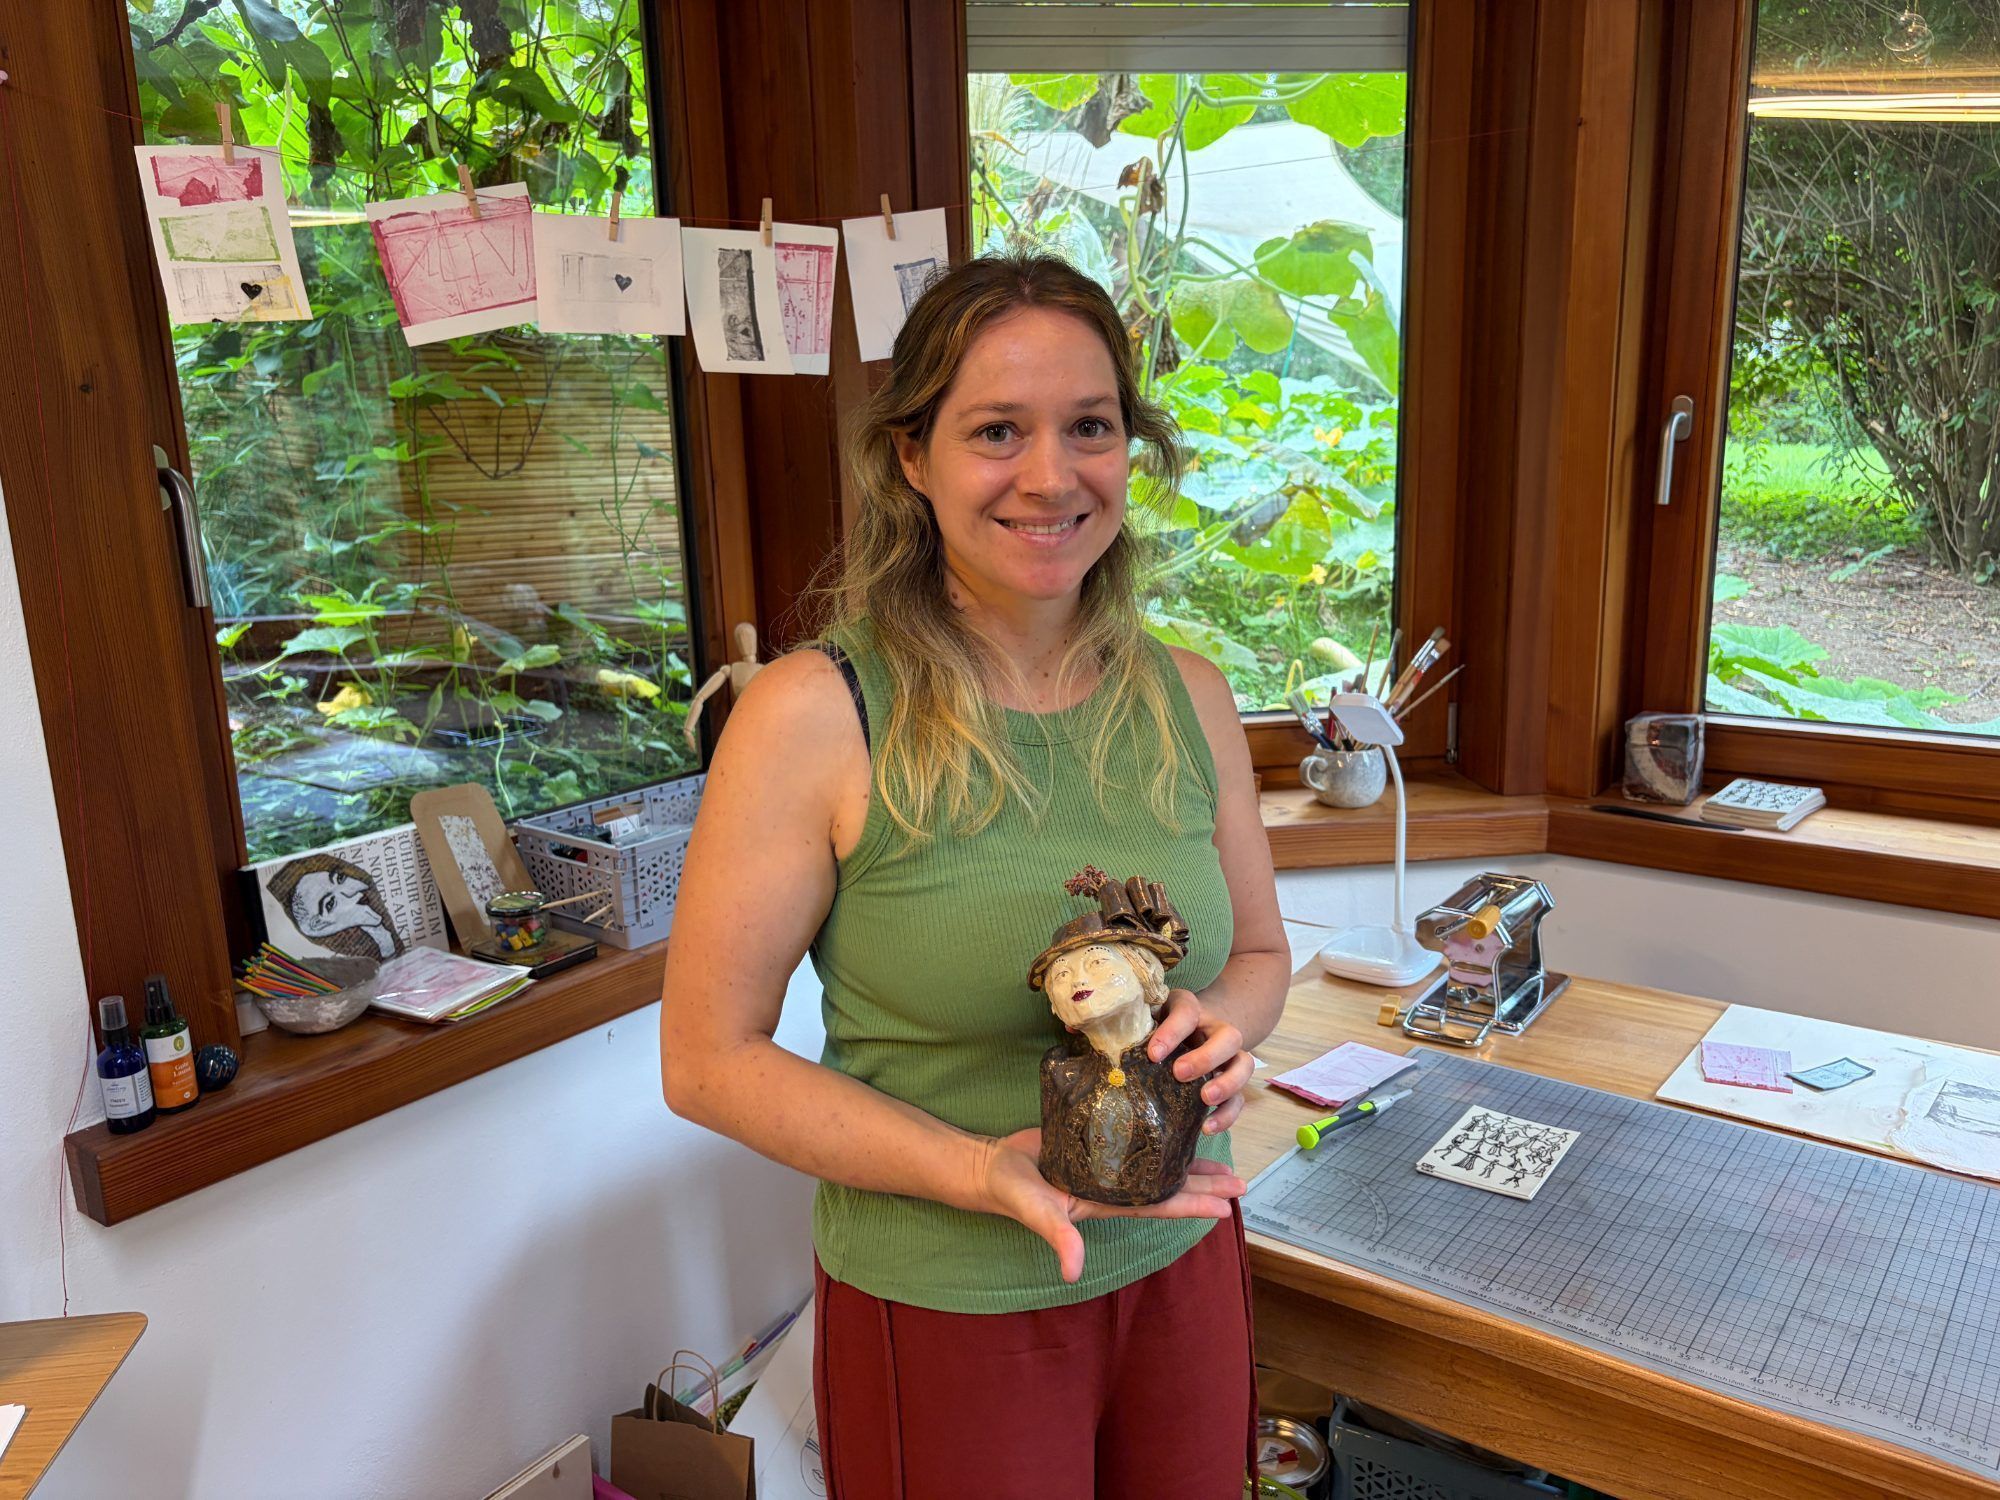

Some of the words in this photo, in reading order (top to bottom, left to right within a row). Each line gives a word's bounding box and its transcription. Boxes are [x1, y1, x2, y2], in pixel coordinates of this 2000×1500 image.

[411, 908, 426, 940] 2011
[429, 916, 441, 936] IM
[1906, 1422, 1922, 1430] 50
